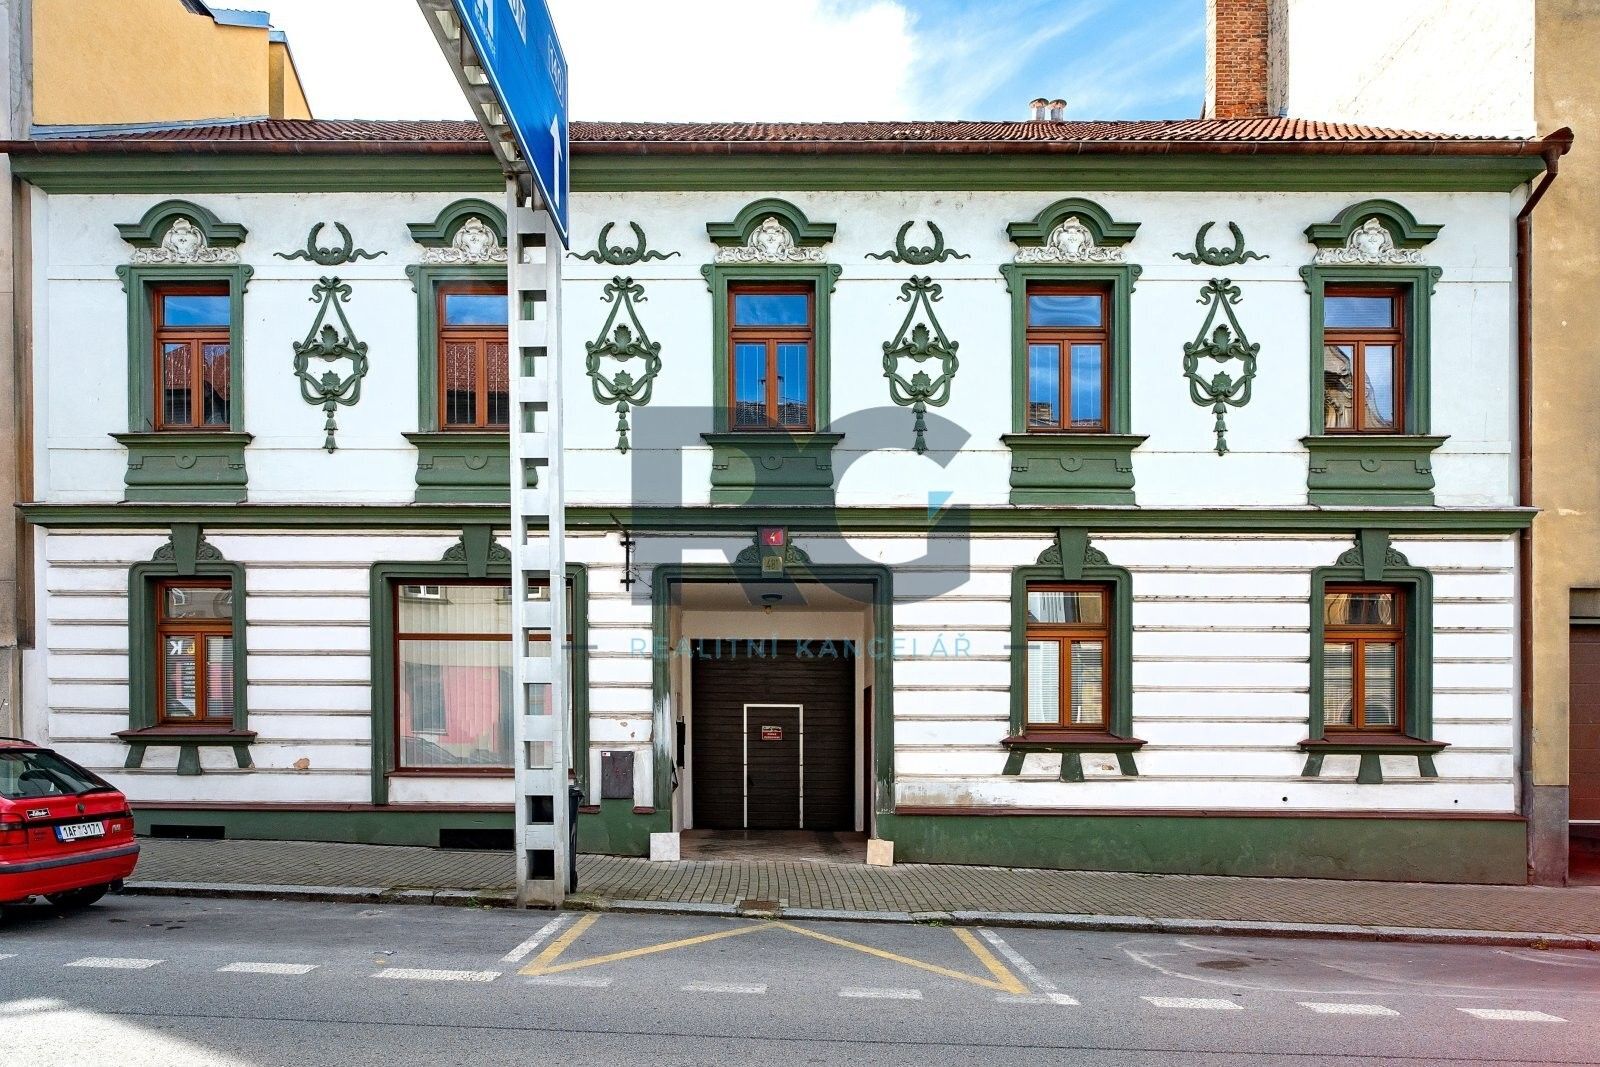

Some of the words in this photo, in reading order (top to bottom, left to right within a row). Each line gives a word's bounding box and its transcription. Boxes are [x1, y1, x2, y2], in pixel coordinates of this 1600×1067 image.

[770, 531, 776, 543] 4
[63, 825, 77, 837] 1AF
[83, 823, 101, 835] 3171
